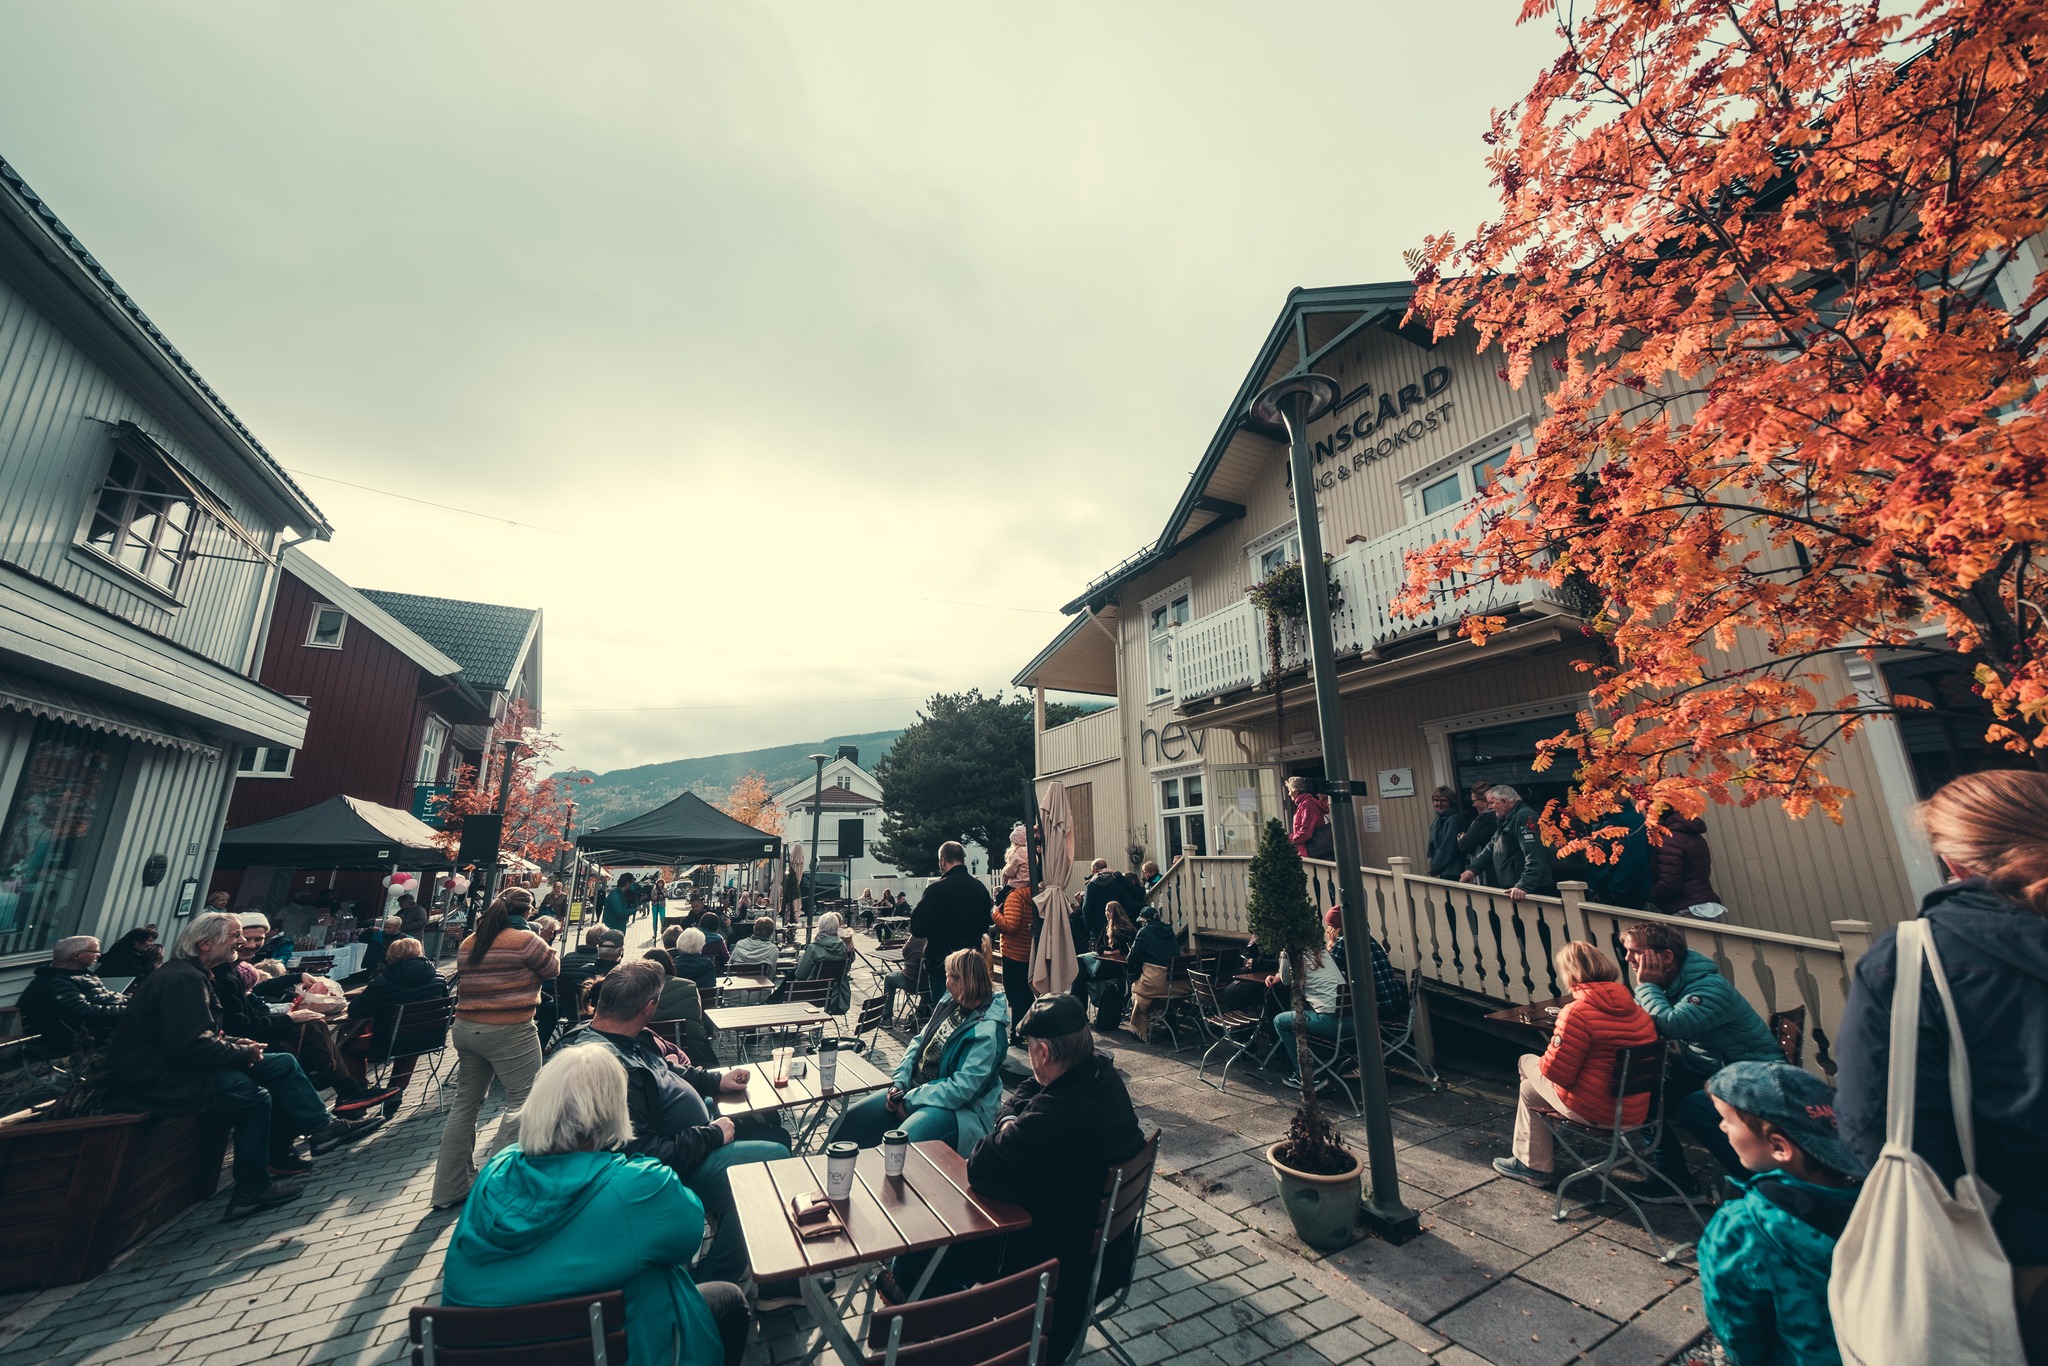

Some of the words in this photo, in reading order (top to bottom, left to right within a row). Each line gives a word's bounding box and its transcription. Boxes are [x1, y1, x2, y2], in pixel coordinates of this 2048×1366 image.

[1285, 366, 1450, 489] JNSGÅRD
[1337, 465, 1349, 480] &
[1353, 401, 1451, 471] FROKOST
[1140, 720, 1205, 765] hev
[421, 789, 436, 822] norli
